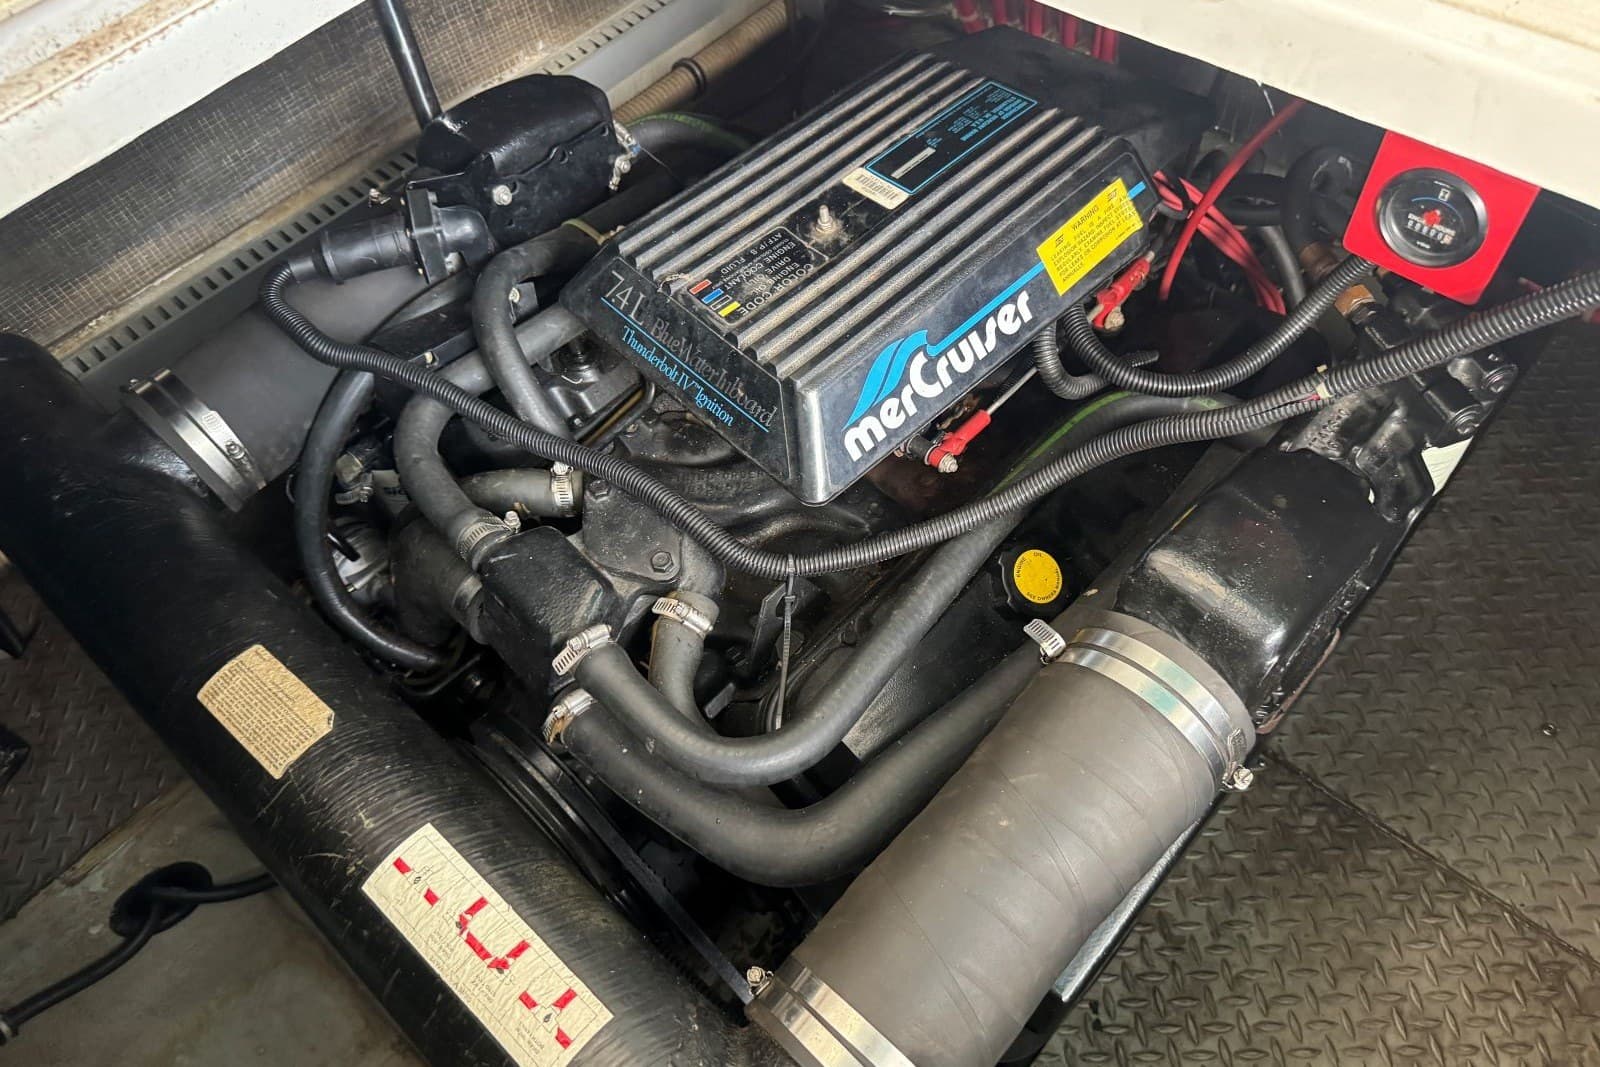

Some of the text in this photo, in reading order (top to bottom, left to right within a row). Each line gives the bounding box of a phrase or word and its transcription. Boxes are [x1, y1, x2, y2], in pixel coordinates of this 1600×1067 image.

[1072, 205, 1099, 231] WARNING
[719, 256, 745, 274] FLUID
[723, 241, 796, 289] ENGINE COOLANT
[764, 256, 791, 274] DRIVE
[766, 261, 799, 284] ENGINE
[739, 262, 814, 316] COLOR CODE
[622, 326, 679, 382] Thunderbolt
[695, 387, 734, 426] Ignition
